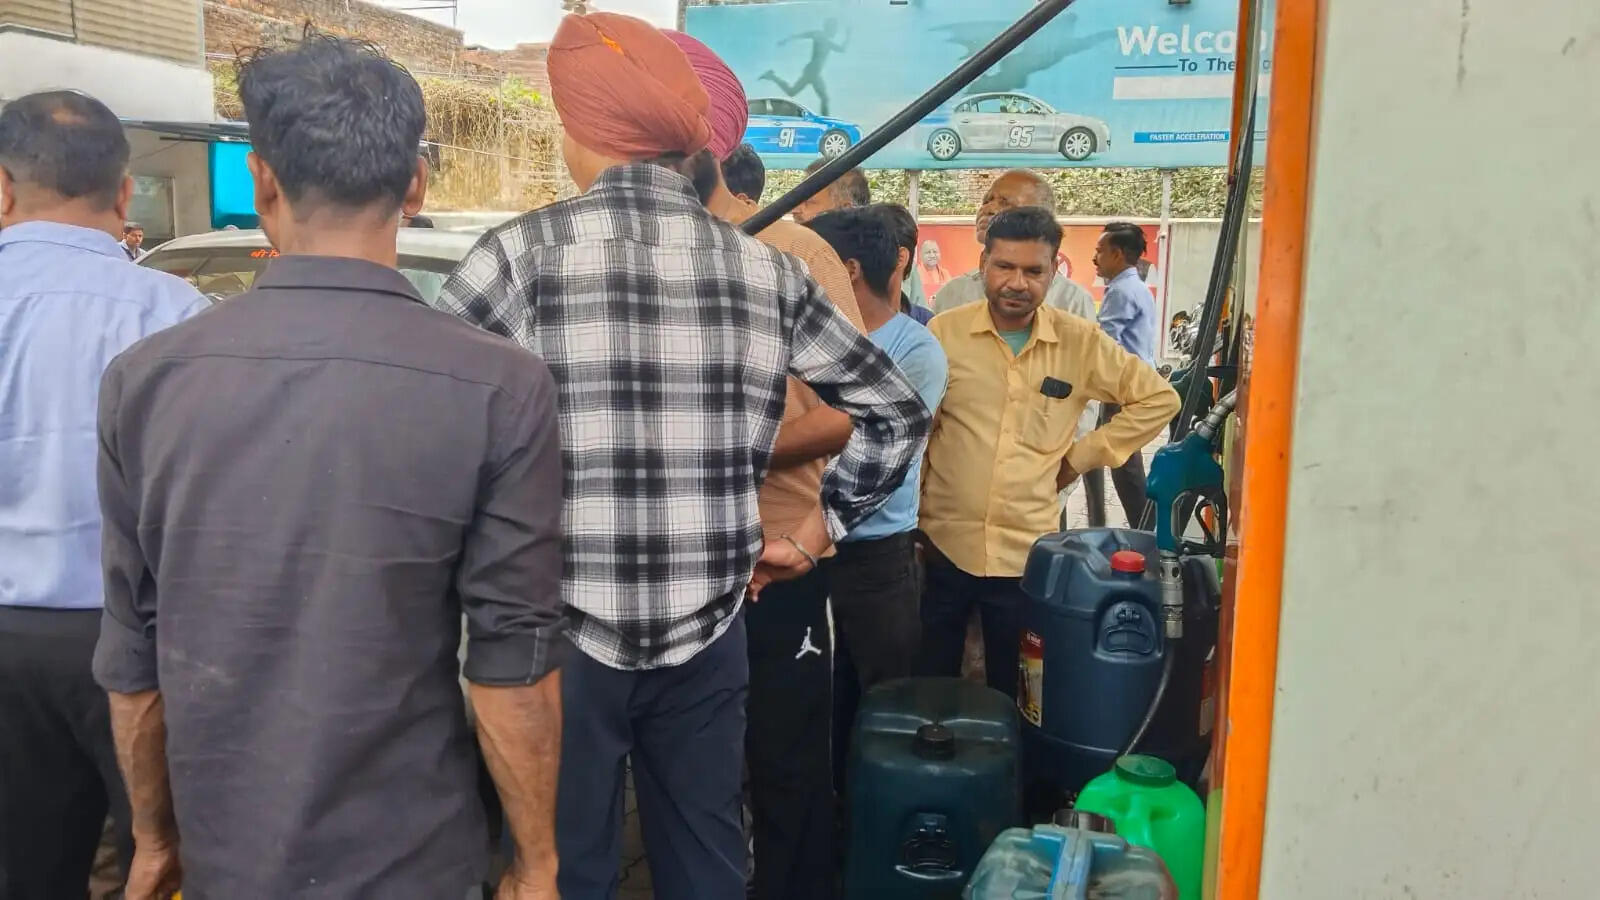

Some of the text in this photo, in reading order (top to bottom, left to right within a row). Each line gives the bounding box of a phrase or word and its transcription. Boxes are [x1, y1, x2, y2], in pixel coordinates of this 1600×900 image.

[1117, 24, 1268, 56] Welco
[1179, 58, 1236, 72] To The
[778, 128, 795, 148] 91
[1008, 126, 1033, 148] 95
[1149, 133, 1225, 141] FASTER ACCELERATION
